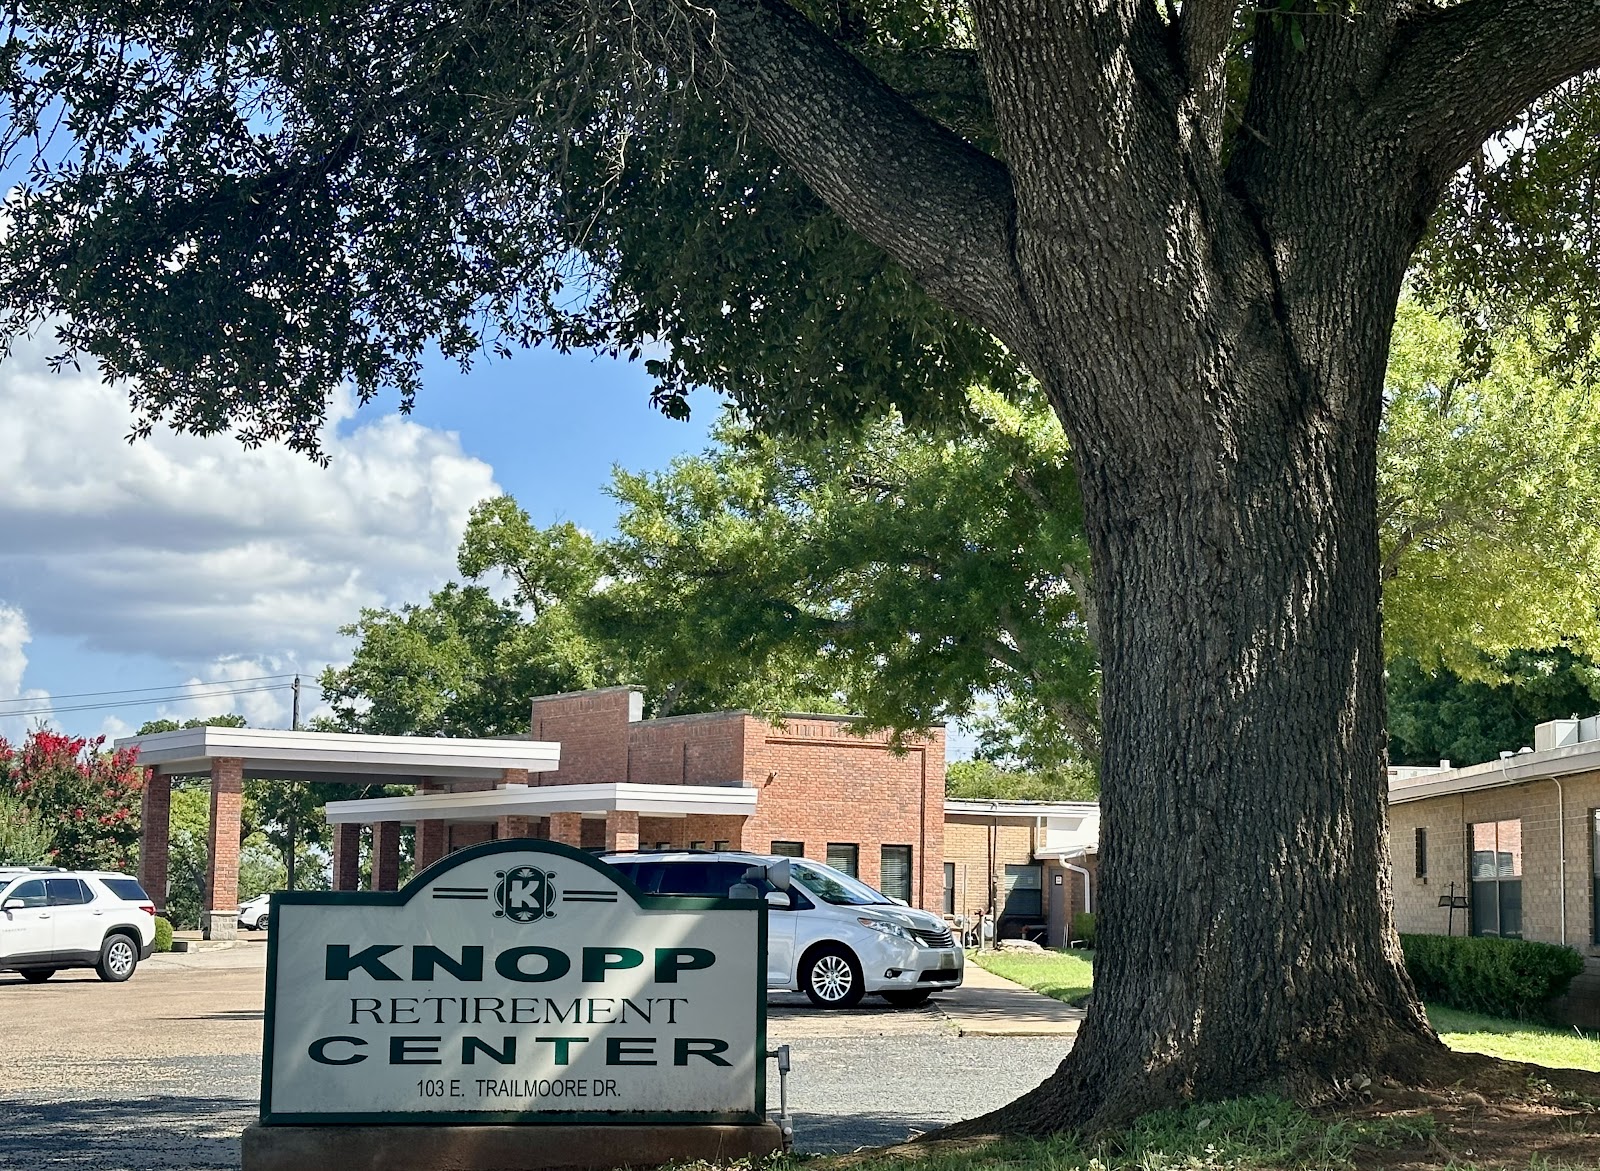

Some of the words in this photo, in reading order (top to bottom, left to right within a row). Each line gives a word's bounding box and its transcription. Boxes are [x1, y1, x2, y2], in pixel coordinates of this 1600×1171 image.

[509, 880, 541, 909] K
[324, 943, 717, 984] KNOPP
[348, 997, 689, 1026] RETIREMENT
[307, 1035, 734, 1067] CENTER
[416, 1079, 445, 1098] 103
[449, 1079, 466, 1098] E.
[475, 1079, 588, 1098] TRAILMOORE
[593, 1079, 621, 1098] DR.
